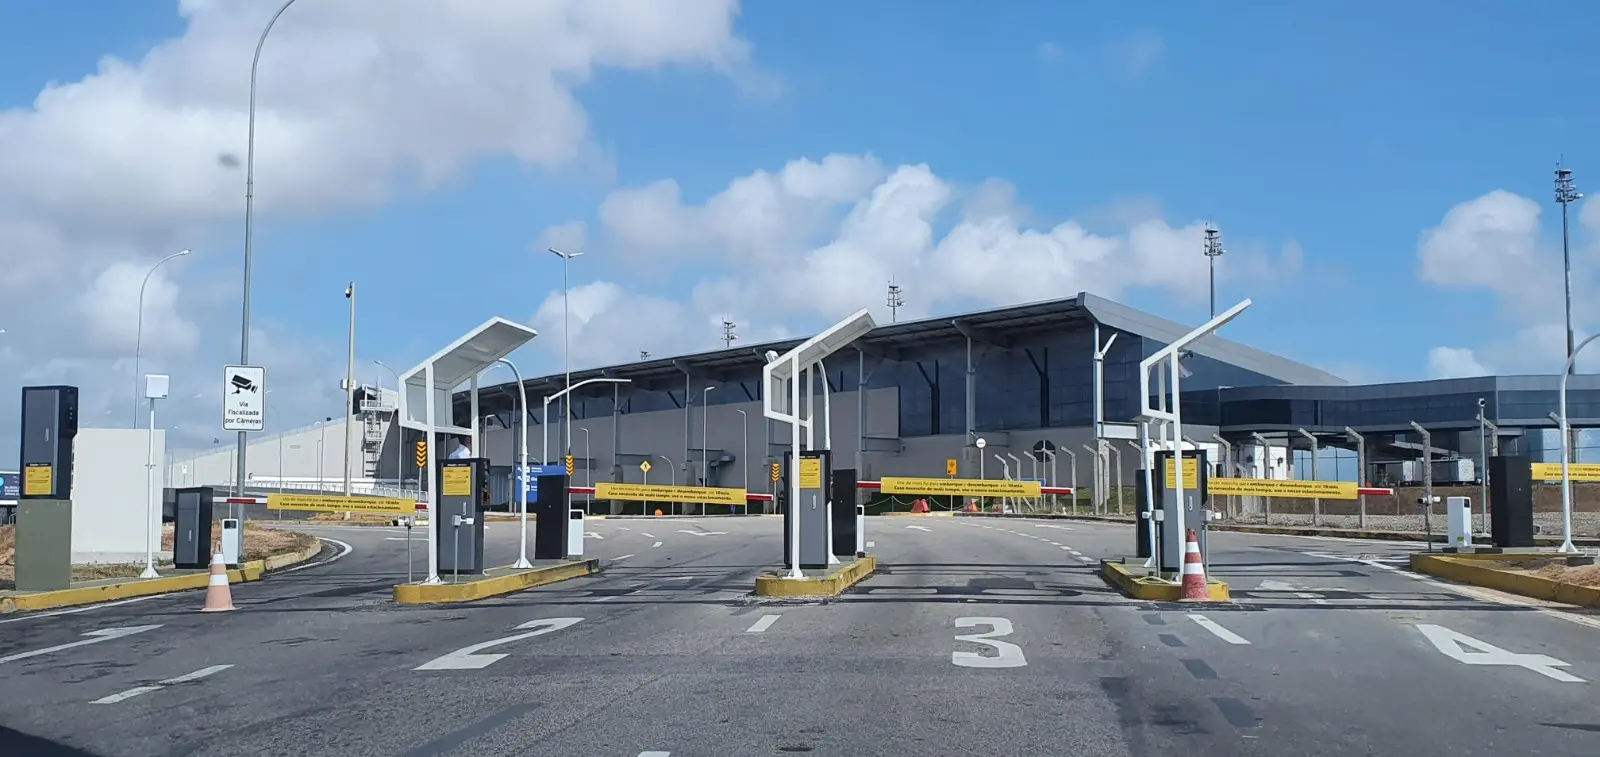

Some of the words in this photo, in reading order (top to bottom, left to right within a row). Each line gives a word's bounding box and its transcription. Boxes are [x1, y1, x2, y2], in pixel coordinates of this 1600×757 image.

[412, 617, 586, 670] 2
[952, 616, 1028, 668] 3
[1415, 624, 1587, 682] 4
